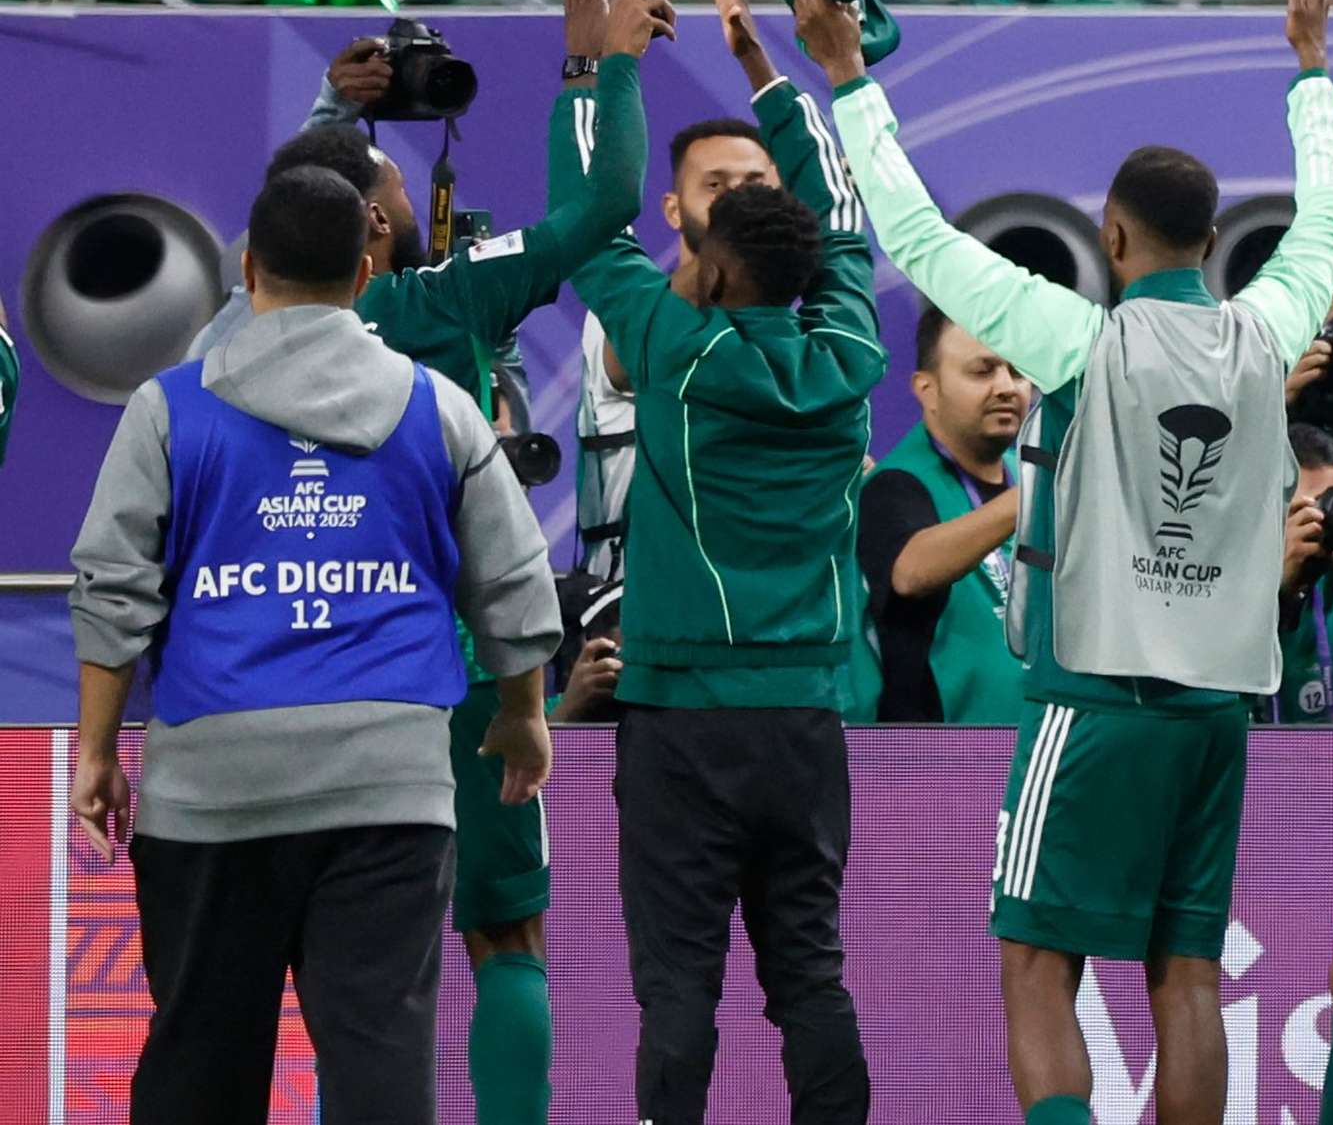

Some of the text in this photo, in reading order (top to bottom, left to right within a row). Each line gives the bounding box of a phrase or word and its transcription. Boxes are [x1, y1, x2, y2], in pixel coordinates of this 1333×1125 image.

[295, 481, 325, 495] AFC
[257, 495, 367, 514] ASIAN CUP
[263, 513, 316, 531] QATAR
[1155, 545, 1187, 560] AFC
[1132, 554, 1222, 582] ASIAN CUP
[193, 560, 417, 598] AFC DIGITAL
[1135, 574, 1172, 595] QATAR
[291, 599, 332, 629] 12
[1304, 691, 1322, 711] 12
